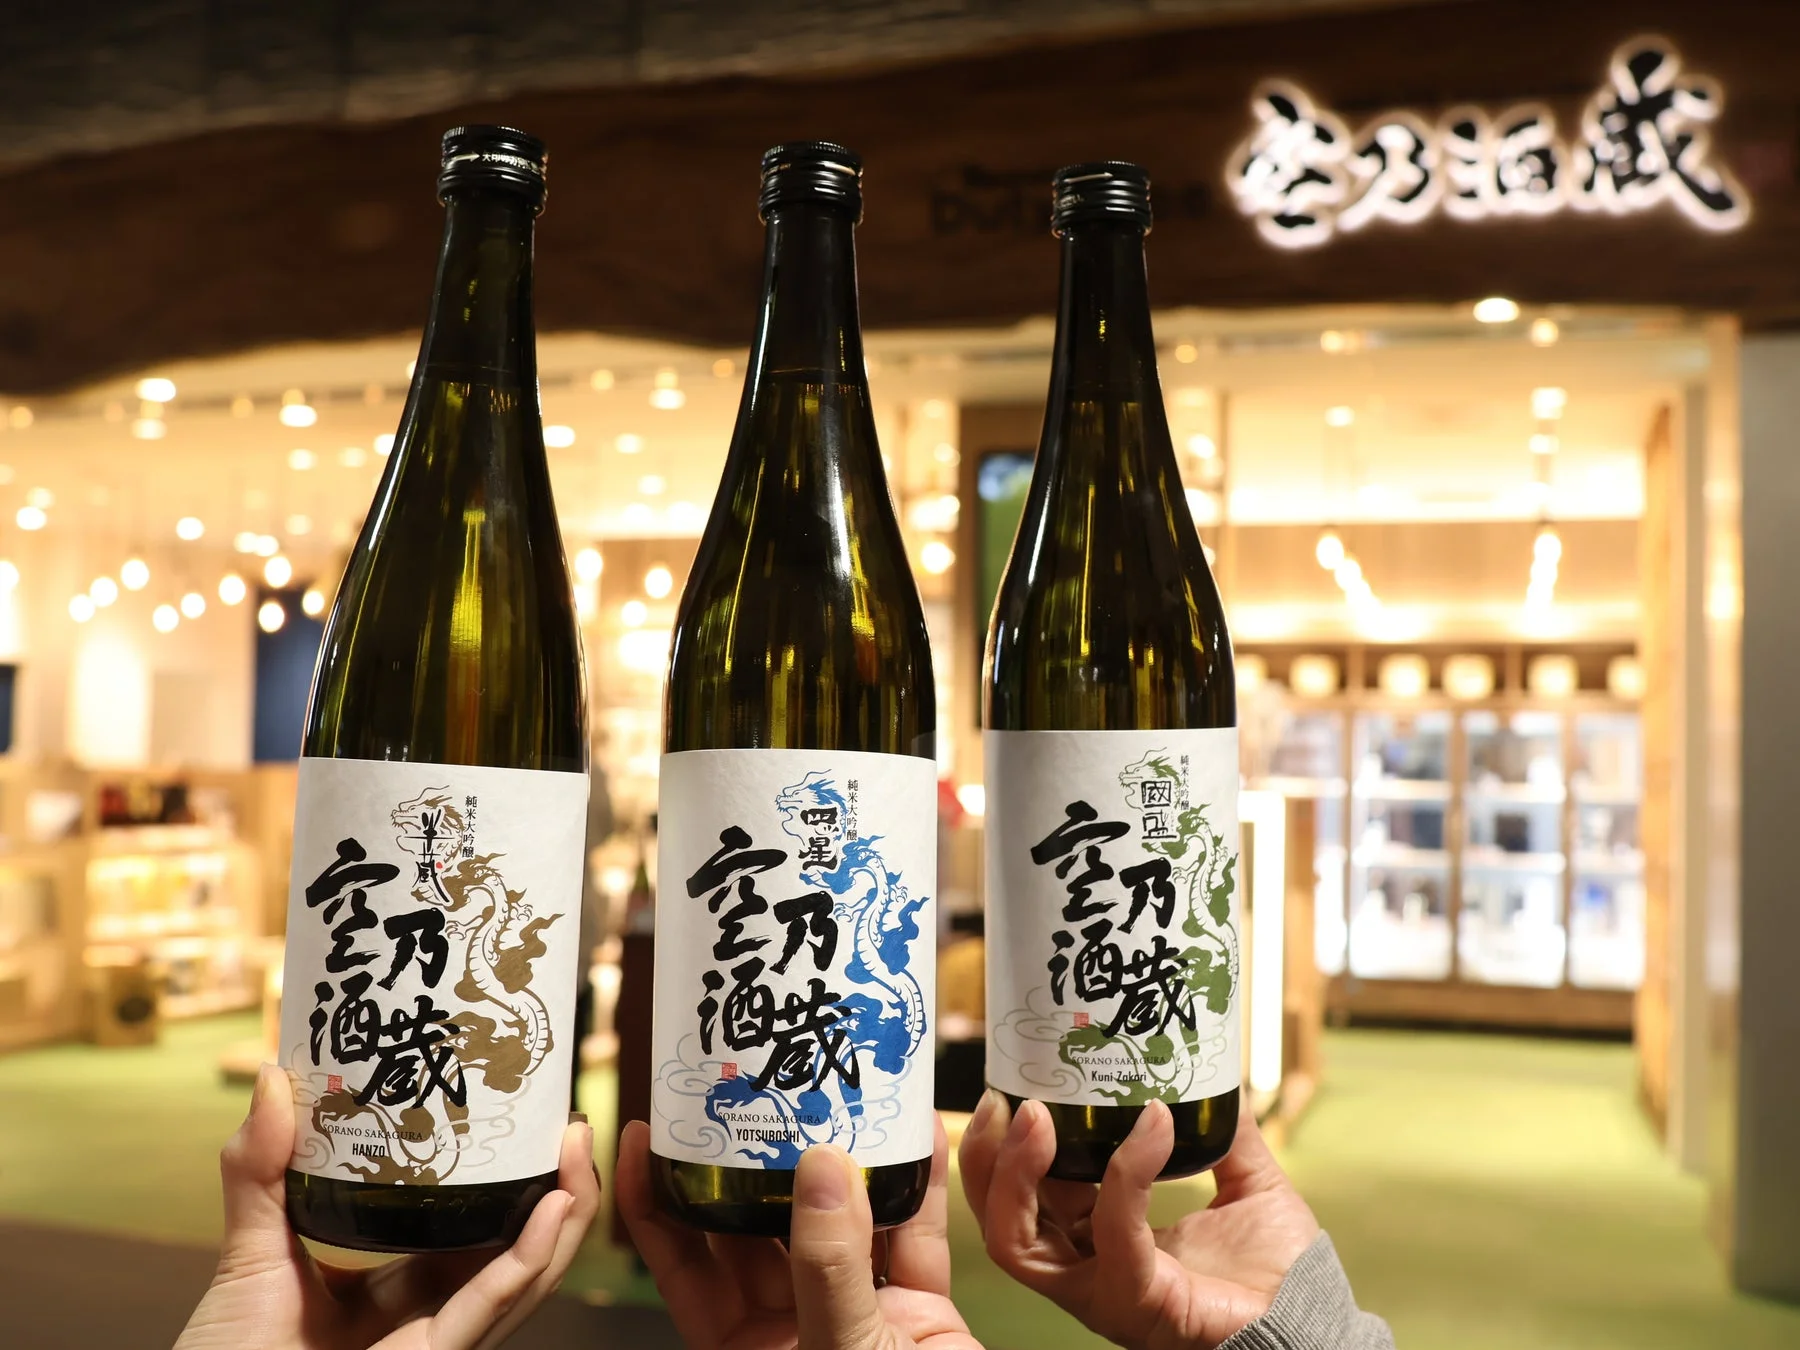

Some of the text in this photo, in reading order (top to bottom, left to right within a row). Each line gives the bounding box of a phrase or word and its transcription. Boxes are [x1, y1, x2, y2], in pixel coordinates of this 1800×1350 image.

[846, 779, 859, 841] 純米大吟醸
[461, 795, 478, 858] 純米大吟醸
[1072, 1056, 1166, 1065] SORANO SAKAGURA
[1091, 1070, 1147, 1082] Kuni Zakari
[718, 1112, 821, 1124] SORANO SAKAGURA
[322, 1123, 423, 1140] SORANO SAKAGURA
[735, 1128, 800, 1143] YOTSUBOSHI
[352, 1143, 386, 1158] HANZO
